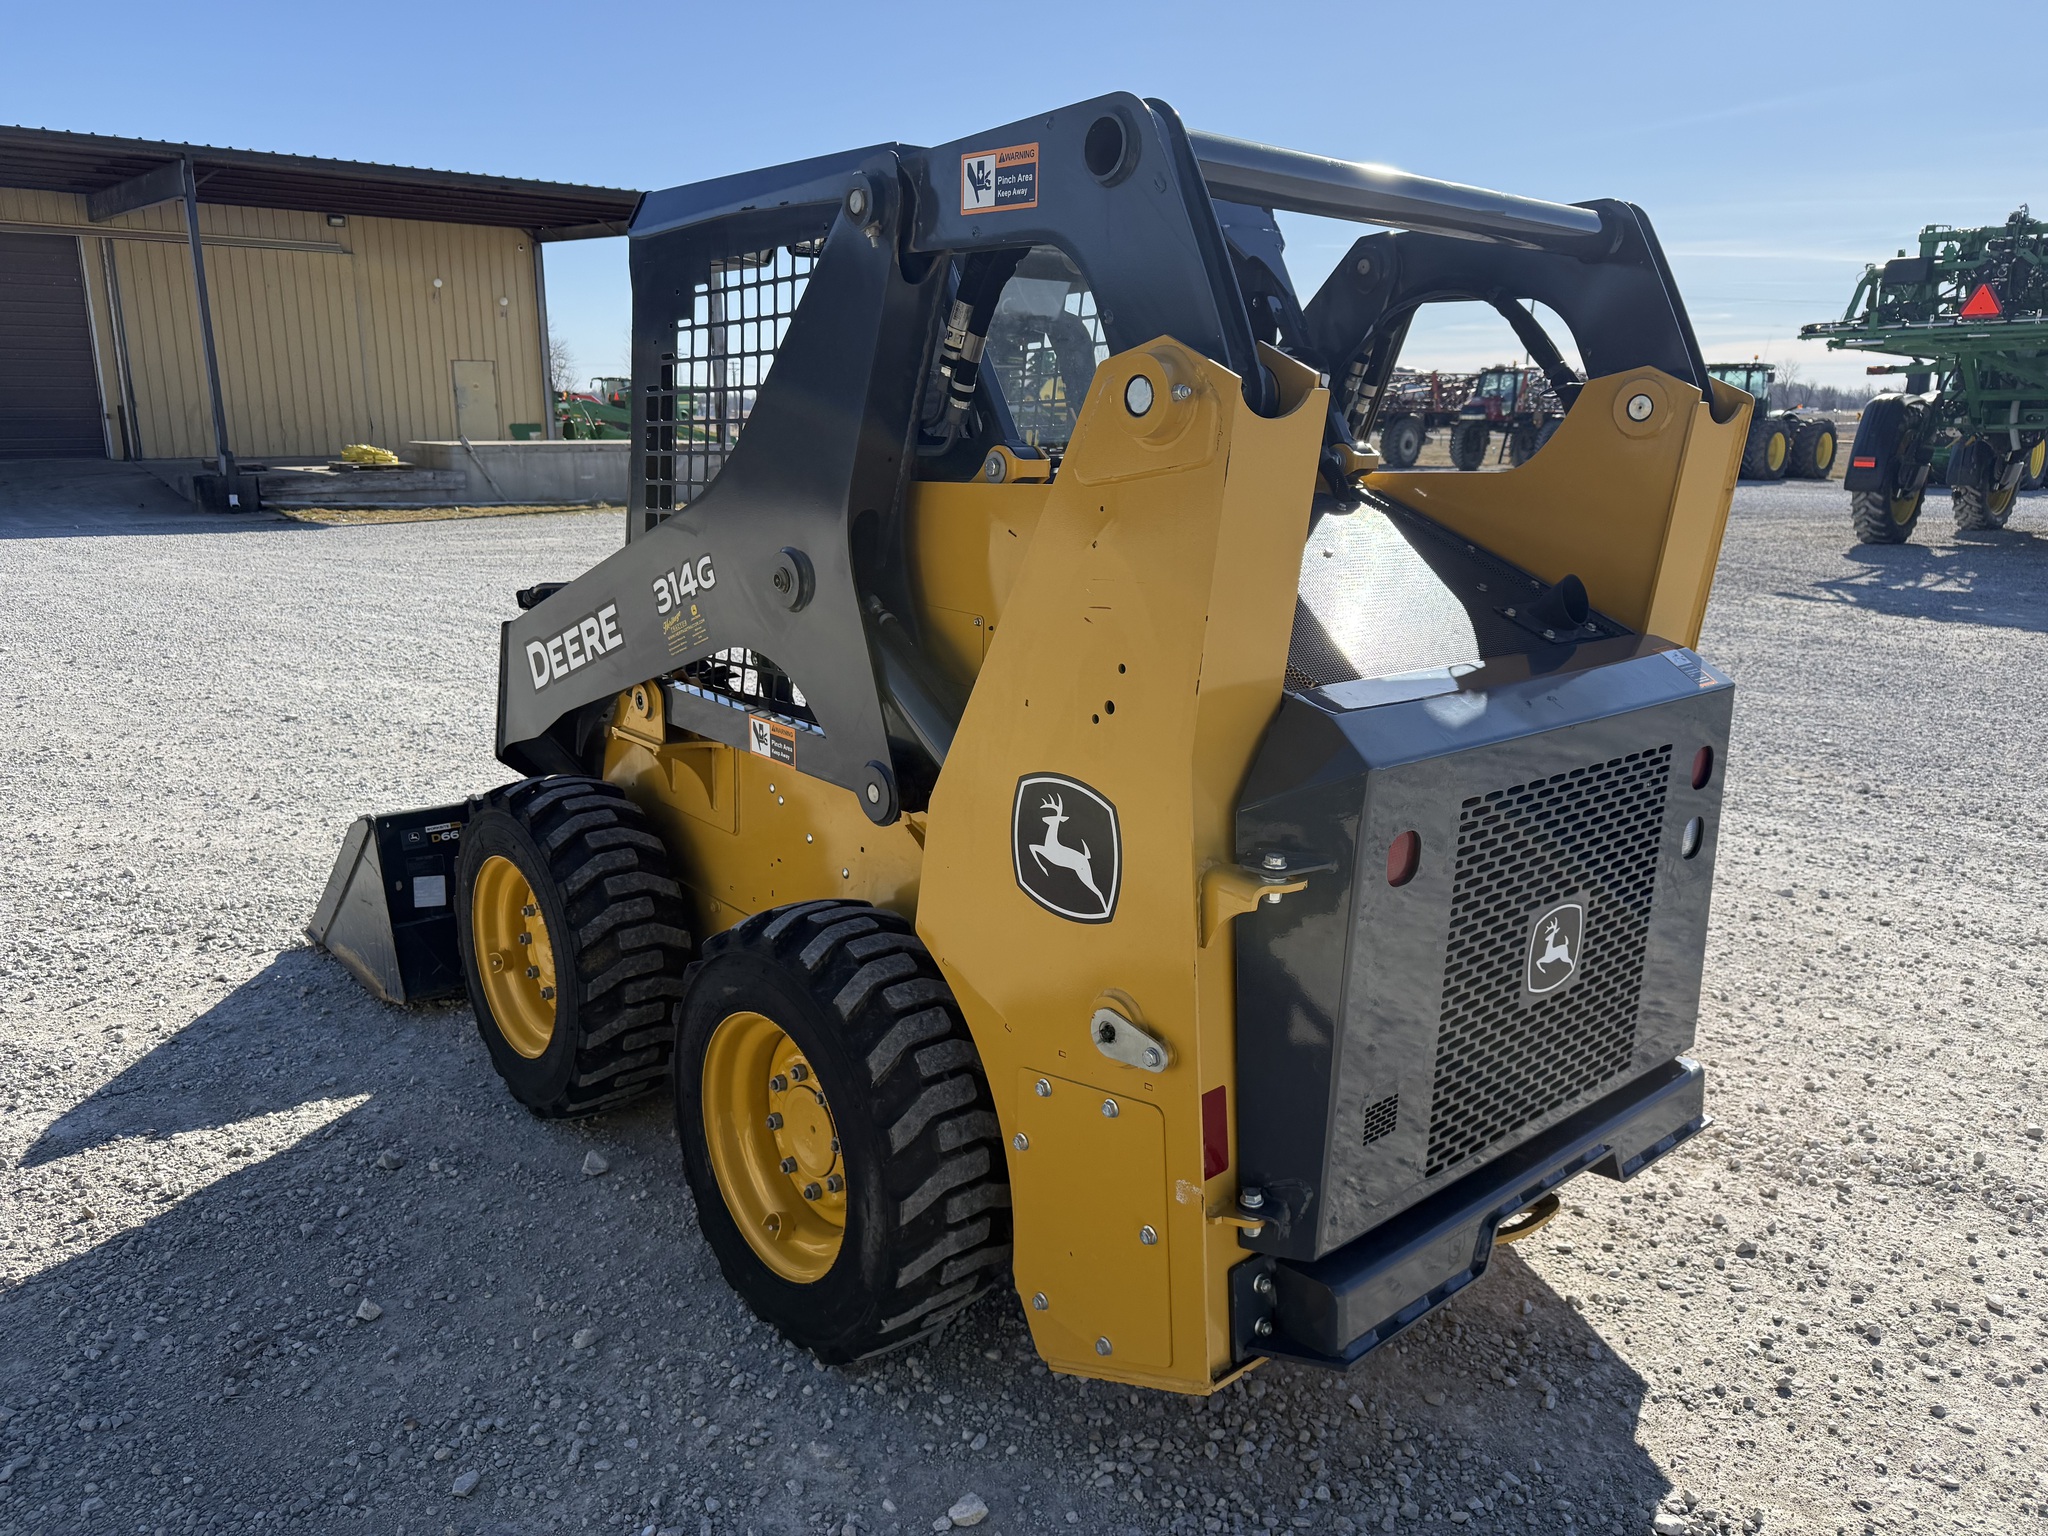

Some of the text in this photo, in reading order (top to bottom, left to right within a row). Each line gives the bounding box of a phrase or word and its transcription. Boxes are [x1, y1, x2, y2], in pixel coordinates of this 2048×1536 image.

[1004, 149, 1035, 162] WARNING
[997, 173, 1033, 185] Pinch Area
[997, 187, 1028, 198] Keep Away
[653, 555, 716, 614] 314G
[526, 603, 623, 690] DEERE
[772, 740, 793, 752] Pinch Area
[431, 830, 460, 843] D66
